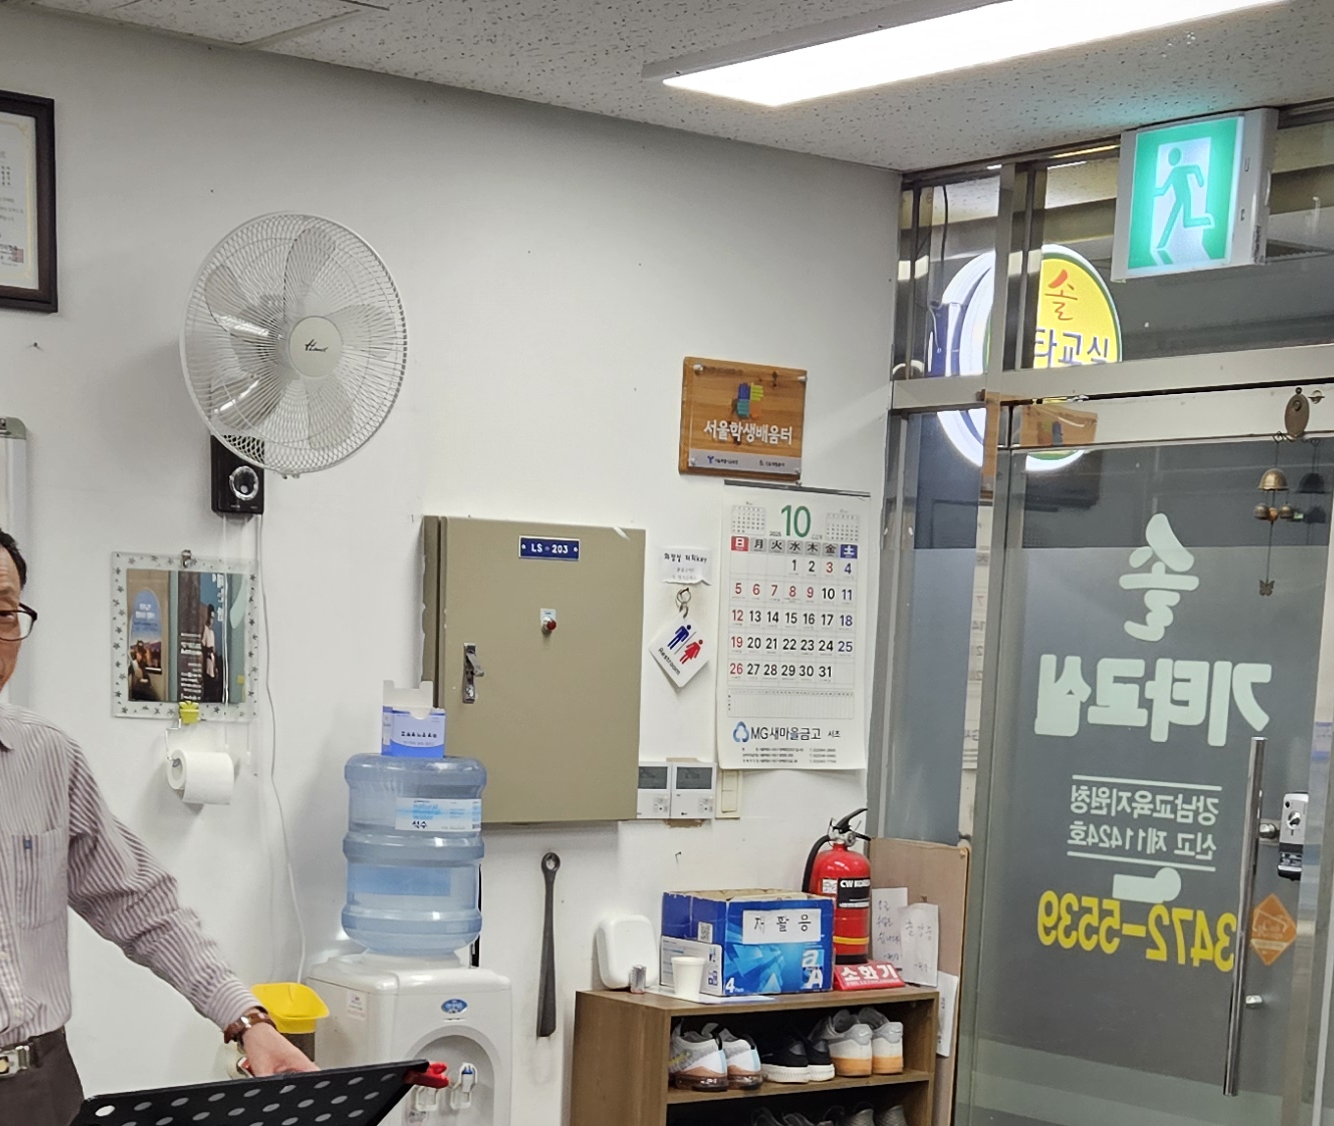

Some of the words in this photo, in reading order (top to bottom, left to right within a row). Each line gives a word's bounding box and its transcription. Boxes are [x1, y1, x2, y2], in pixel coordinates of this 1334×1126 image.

[1044, 269, 1078, 321] 솔
[1034, 325, 1109, 368] 타교실
[704, 419, 793, 446] 서울학생배움터
[781, 505, 811, 538] 10
[531, 543, 543, 553] LS
[551, 544, 569, 554] 203
[754, 539, 764, 549] 月
[771, 540, 783, 550] 火
[789, 541, 801, 551] 水
[807, 543, 818, 552] 木
[825, 543, 837, 553] 金
[843, 545, 855, 555] 土
[792, 559, 797, 571] 1
[808, 560, 815, 573] 2
[826, 561, 834, 573] 3
[844, 563, 852, 574] 4
[734, 582, 742, 594] 5
[752, 583, 760, 596] 6
[771, 584, 778, 596] 7
[788, 585, 796, 597] 8
[807, 586, 814, 599] 9
[821, 587, 835, 600] 10
[841, 589, 852, 601] 11
[732, 609, 744, 622] 12
[749, 610, 762, 623] 13
[766, 611, 779, 623] 14
[785, 612, 798, 624] 15
[802, 613, 815, 625] 16
[821, 613, 834, 626] 17
[839, 614, 853, 627] 18
[731, 636, 743, 648] 19
[747, 636, 761, 649] 20
[765, 637, 777, 649] 21
[782, 638, 797, 651] 22
[800, 639, 815, 651] 23
[818, 639, 834, 652] 24
[838, 640, 853, 653] 25
[657, 647, 681, 676] Restroom
[729, 662, 743, 675] 26
[747, 663, 760, 675] 27
[763, 663, 778, 676] 28
[781, 664, 796, 677] 29
[798, 665, 814, 677] 30
[818, 665, 832, 678] 31
[841, 964, 898, 981] 소화기
[725, 977, 735, 993] 4
